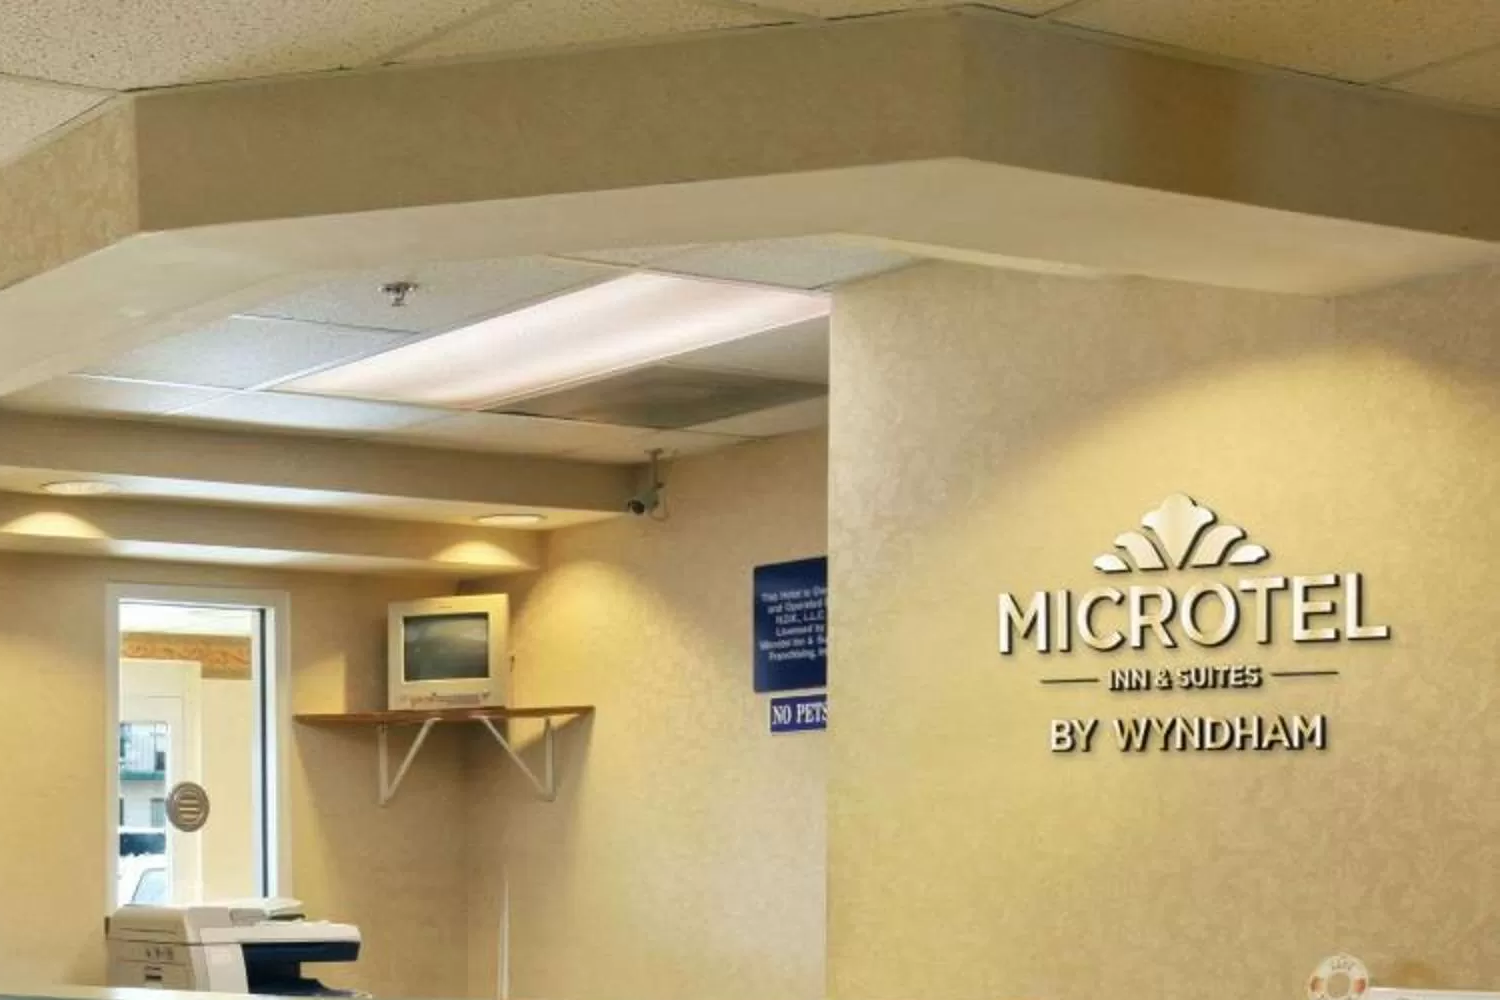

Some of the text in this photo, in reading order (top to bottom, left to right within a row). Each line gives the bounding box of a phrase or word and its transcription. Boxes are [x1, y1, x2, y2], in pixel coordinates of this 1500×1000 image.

[997, 572, 1390, 654] MICROTEL
[1108, 665, 1263, 691] INN & SUITES
[772, 704, 792, 725] NO
[1051, 714, 1327, 752] BY WYNDHAM
